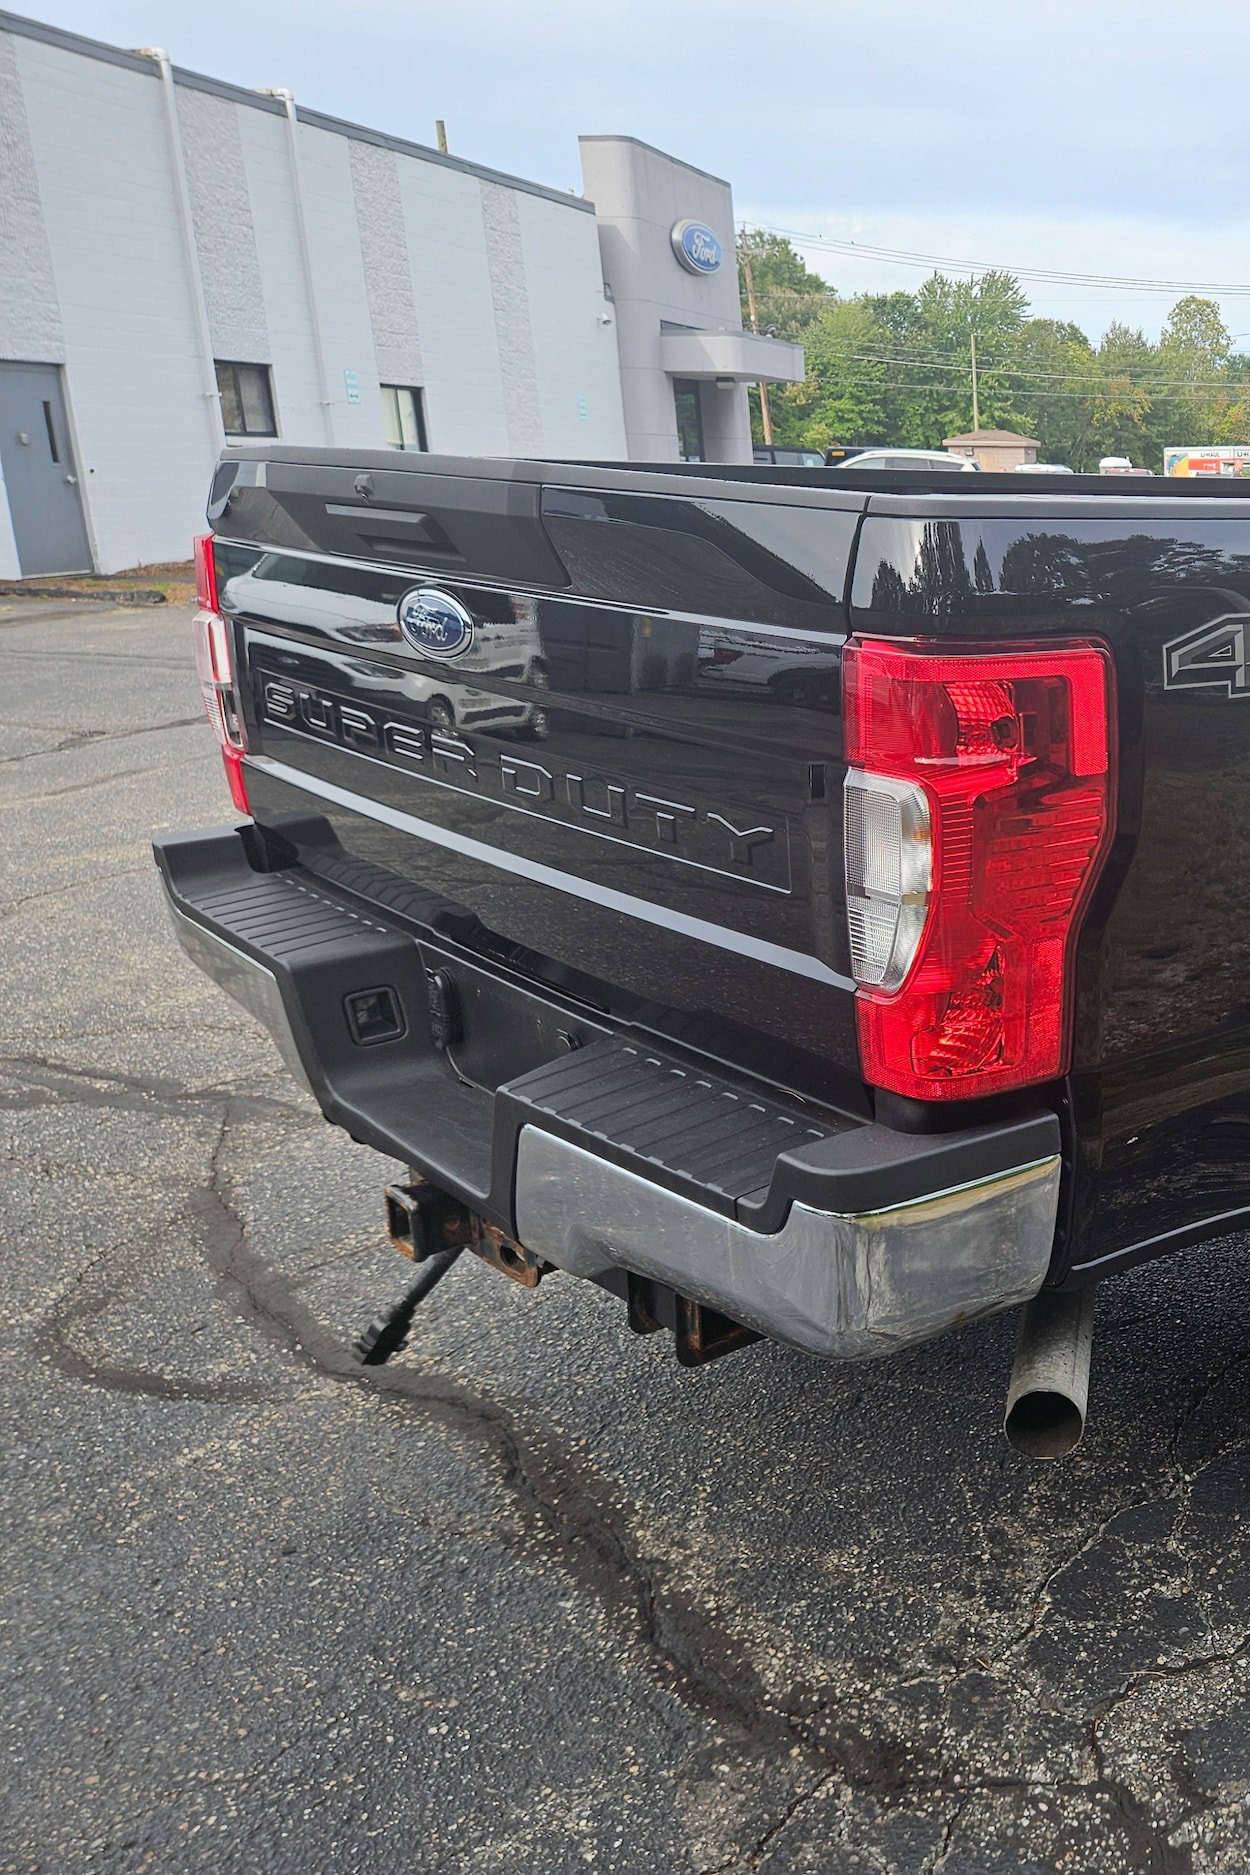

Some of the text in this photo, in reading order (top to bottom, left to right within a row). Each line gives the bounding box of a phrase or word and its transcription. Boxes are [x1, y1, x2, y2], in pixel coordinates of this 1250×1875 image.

[692, 231, 718, 265] Ford
[406, 602, 448, 641] Ford
[264, 681, 776, 867] SUPER DUTY
